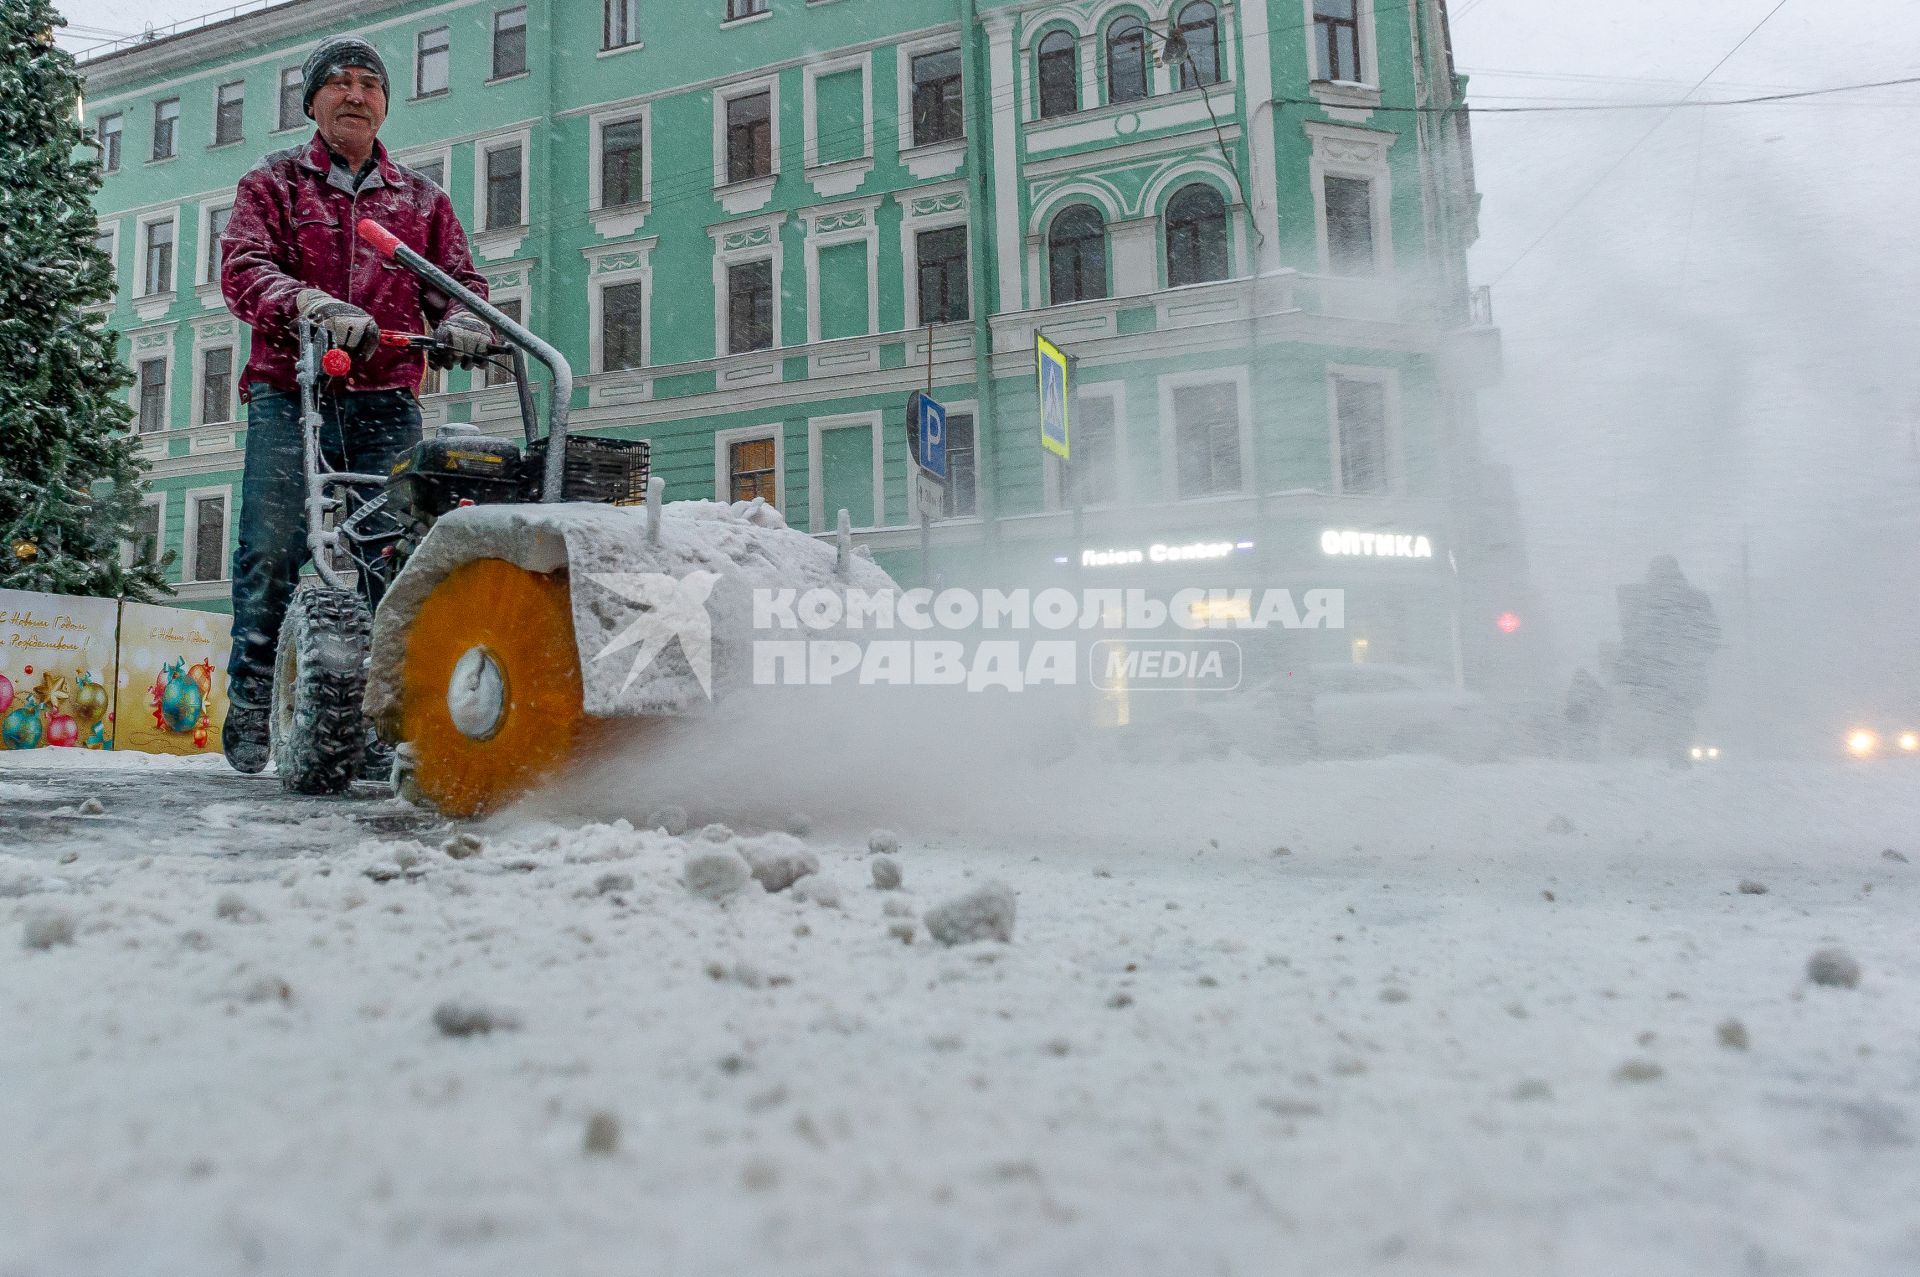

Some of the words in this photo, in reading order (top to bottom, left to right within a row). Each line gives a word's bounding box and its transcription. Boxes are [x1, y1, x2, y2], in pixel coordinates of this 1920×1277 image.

[926, 407, 942, 462] P
[1321, 530, 1432, 557] ОПТИКА
[54, 615, 88, 630] Годом
